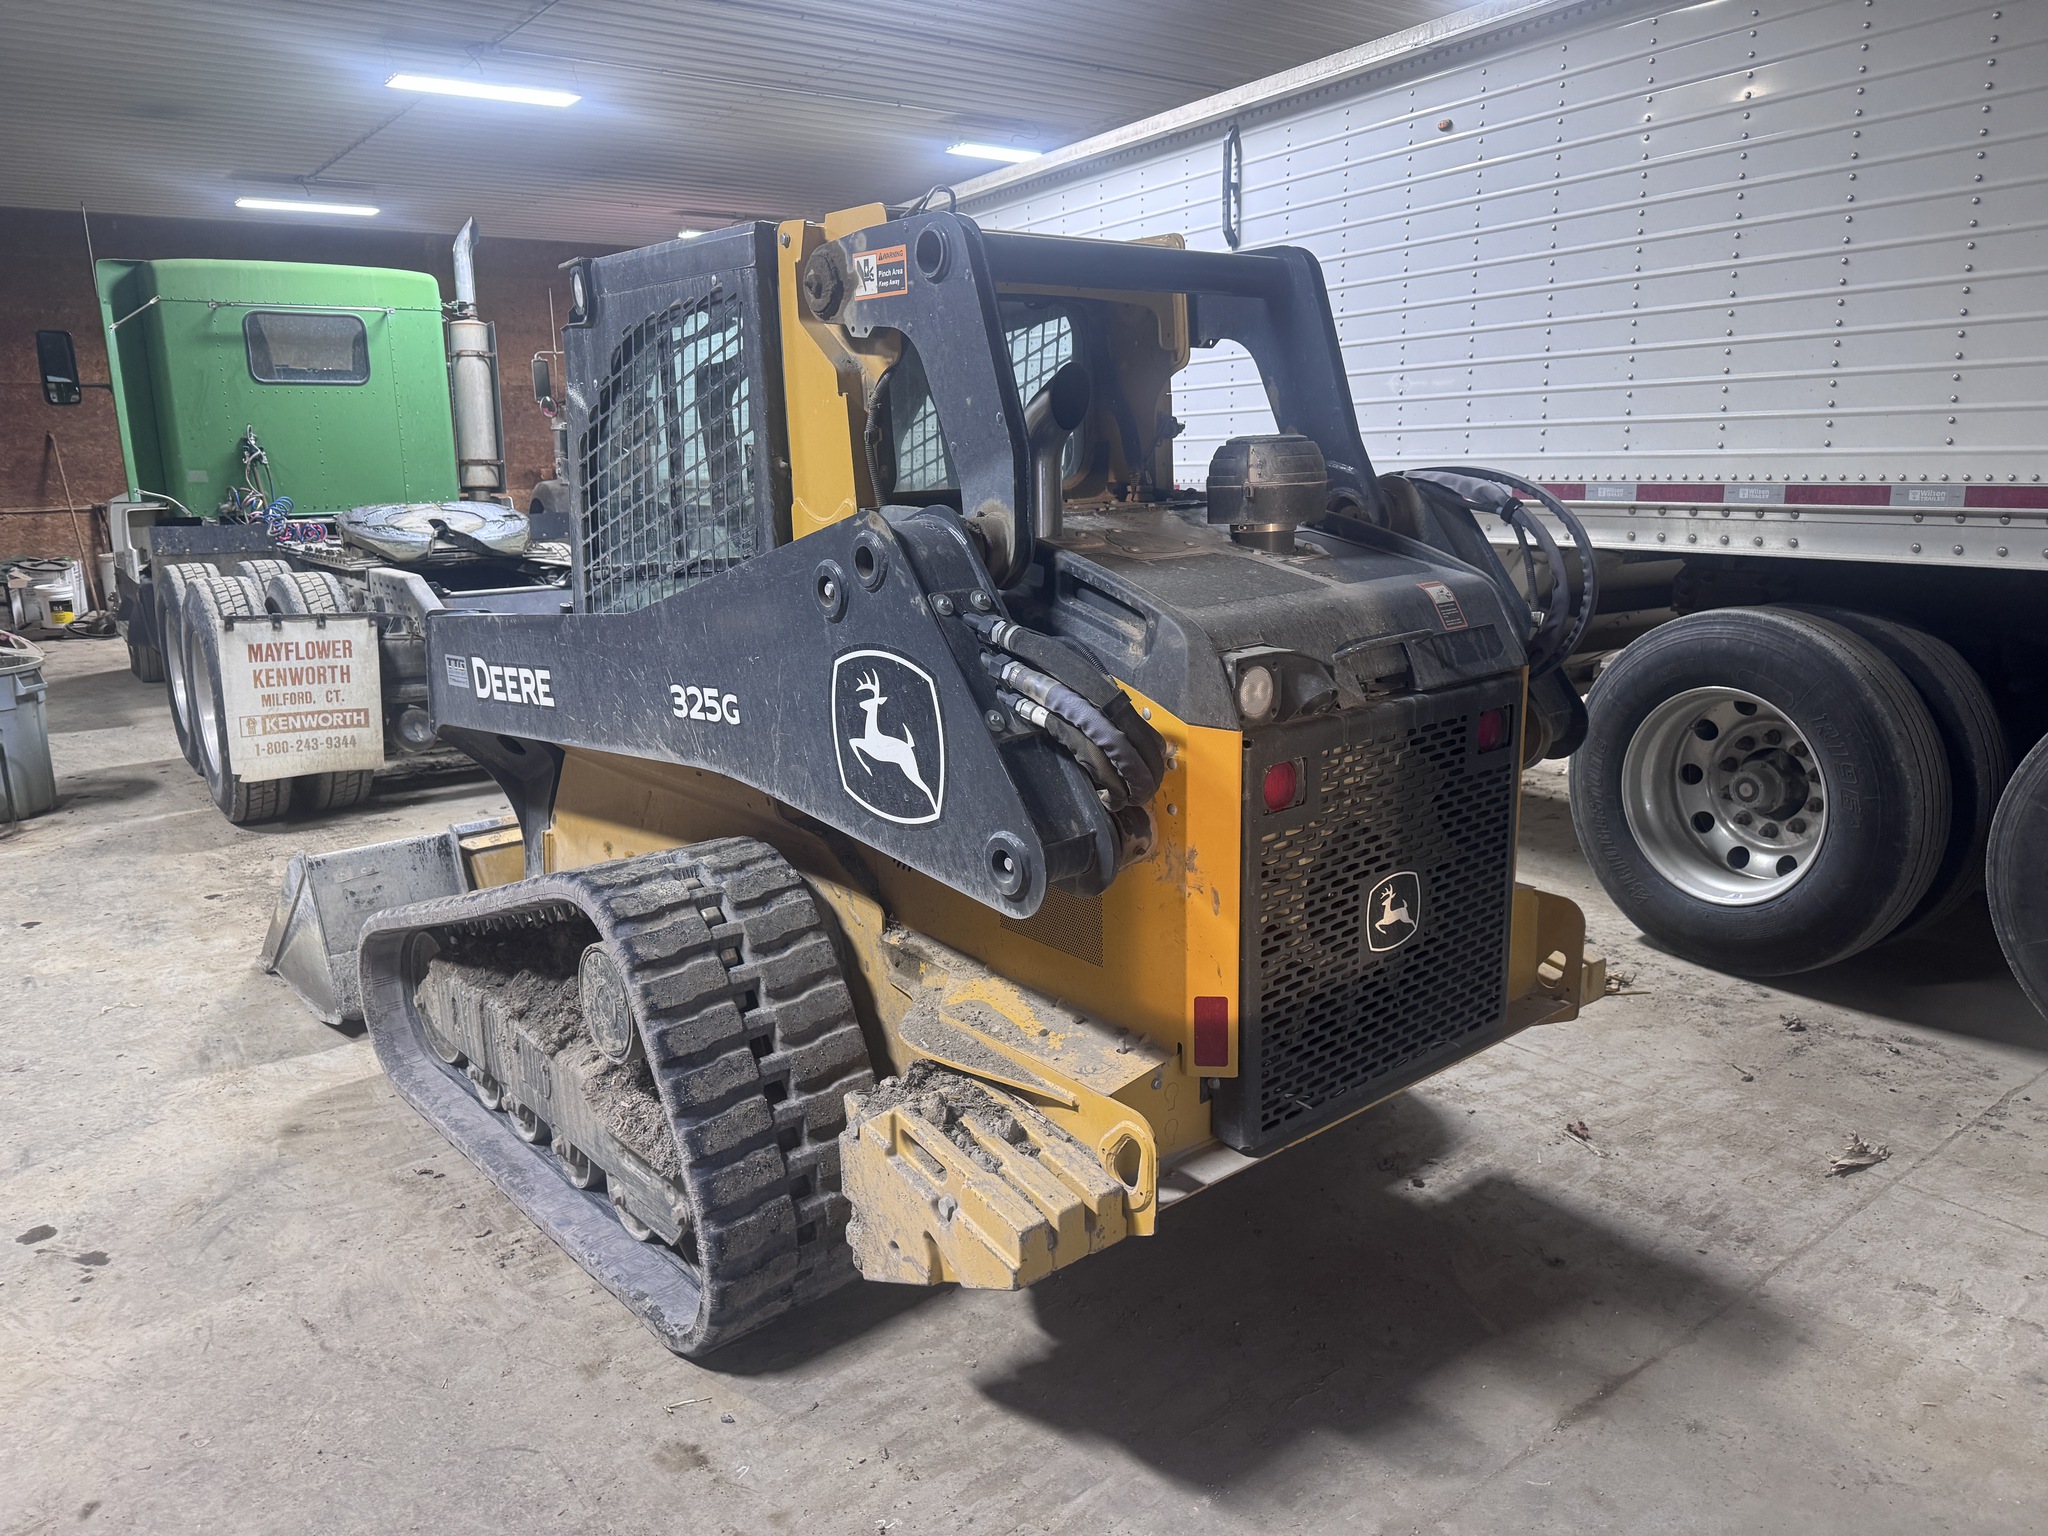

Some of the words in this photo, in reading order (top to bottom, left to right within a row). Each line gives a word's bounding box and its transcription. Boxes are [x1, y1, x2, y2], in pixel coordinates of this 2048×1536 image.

[878, 269, 891, 278] Pinch
[247, 640, 353, 663] MAYFLOWER
[253, 665, 351, 689] KENWORTH
[471, 656, 555, 707] DEERE
[261, 691, 316, 707] MILFORD,
[325, 690, 345, 704] CT.
[670, 684, 741, 725] 325G
[265, 711, 366, 732] KENWORTH
[254, 735, 358, 757] 1-800-243-9344
